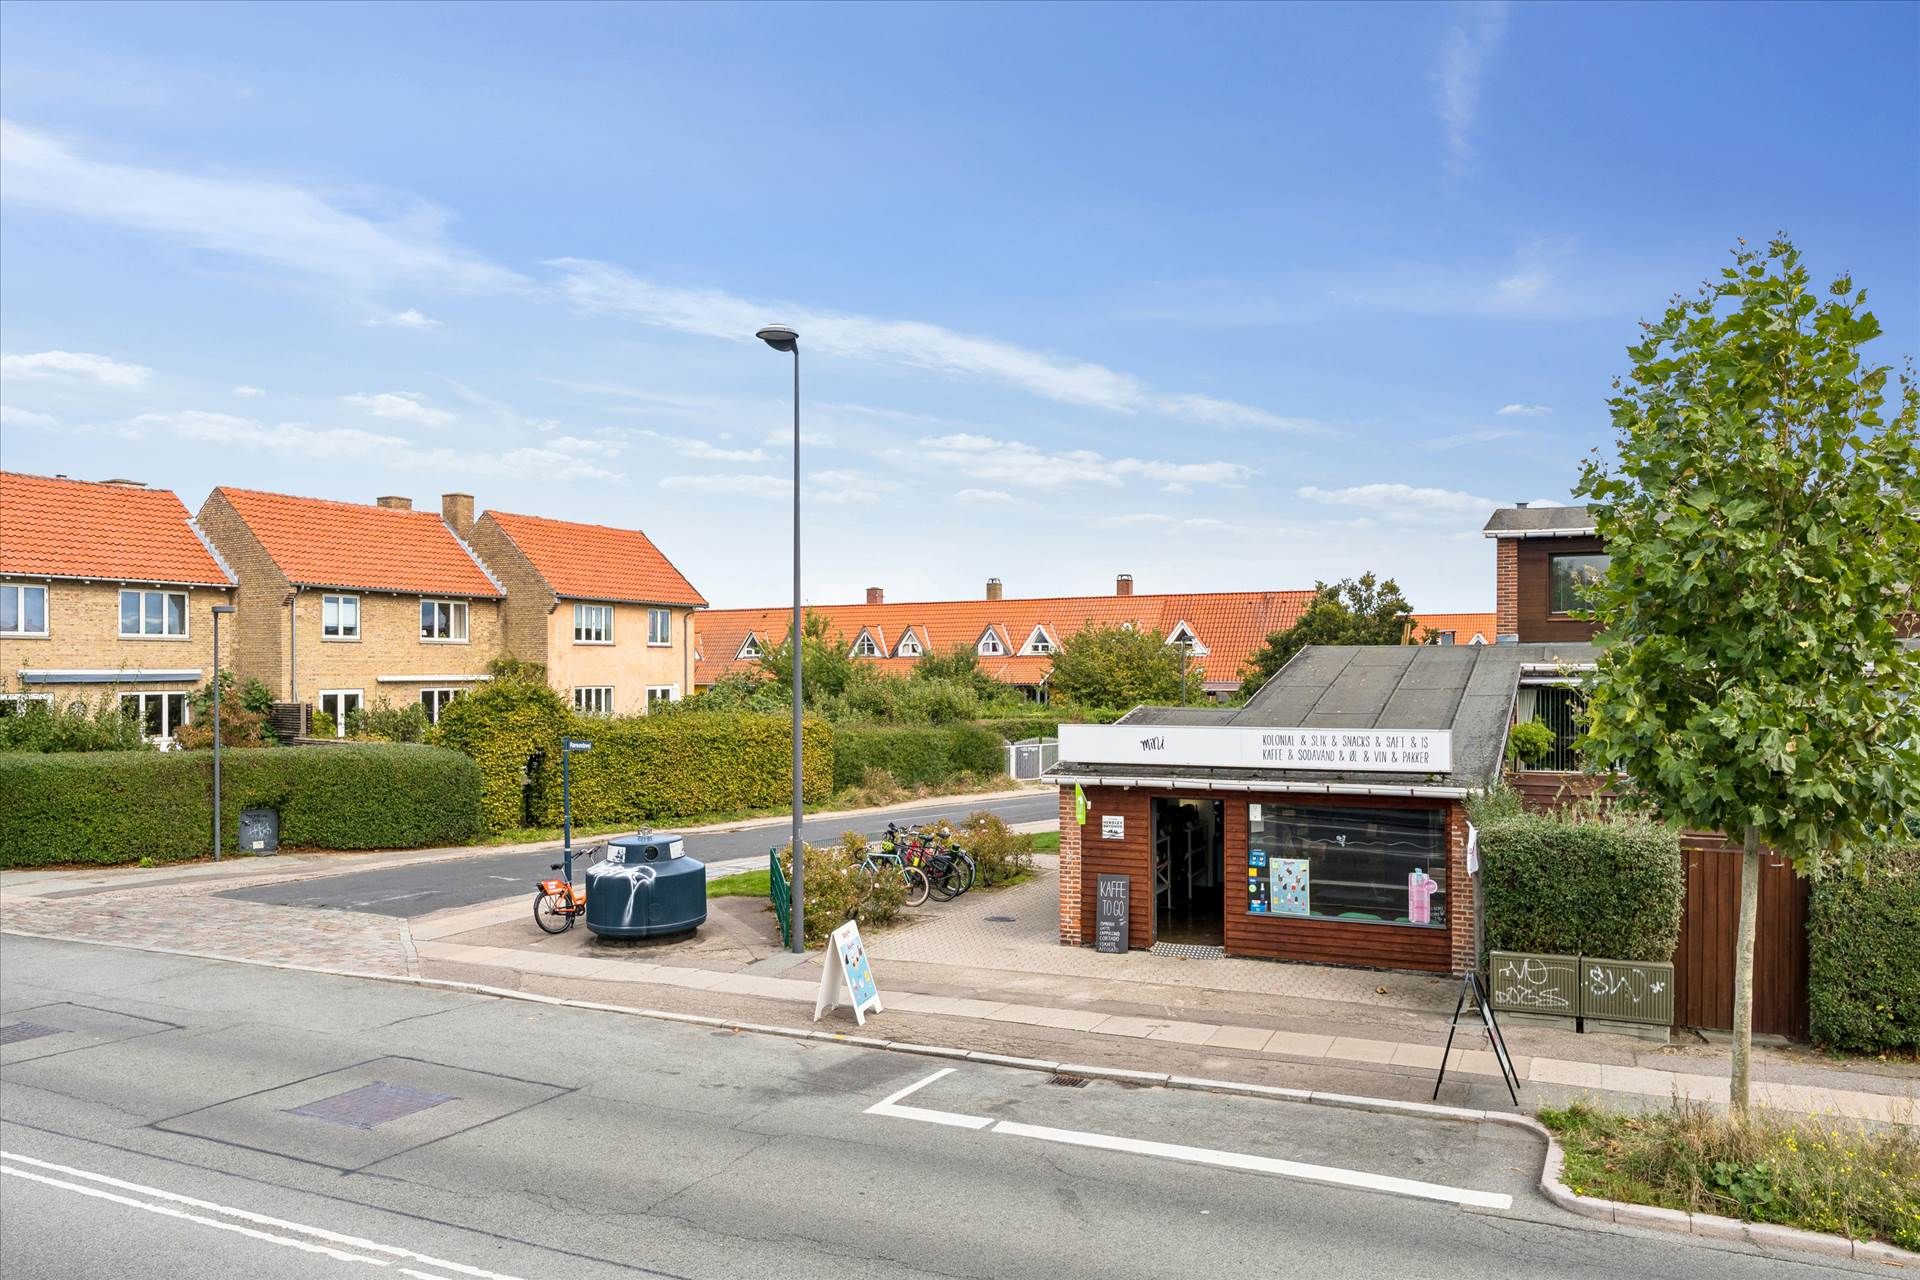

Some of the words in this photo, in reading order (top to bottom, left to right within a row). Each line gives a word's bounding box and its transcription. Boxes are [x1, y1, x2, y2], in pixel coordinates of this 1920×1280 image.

[1140, 736, 1165, 751] mini
[1262, 734, 1294, 747] KOLONIAL
[1300, 734, 1307, 746] &
[1311, 735, 1327, 747] SLIK
[1331, 735, 1338, 747] &
[1342, 735, 1371, 748] SNACKS
[1375, 736, 1382, 748] &
[1386, 736, 1405, 748] SAFT
[1410, 736, 1417, 748] &
[1421, 736, 1429, 749] IS
[1262, 748, 1284, 761] KAFFE
[1287, 748, 1294, 761] &
[1298, 749, 1335, 762] SODAVAND
[1339, 750, 1345, 761] &
[1349, 750, 1357, 762] ØL
[1363, 750, 1370, 762] &
[1374, 750, 1387, 763] VIN
[1391, 751, 1398, 763] &
[1402, 751, 1430, 764] PAKKER
[1100, 880, 1127, 898] KAFFE
[1102, 899, 1111, 916] TO
[1113, 900, 1125, 917] GO
